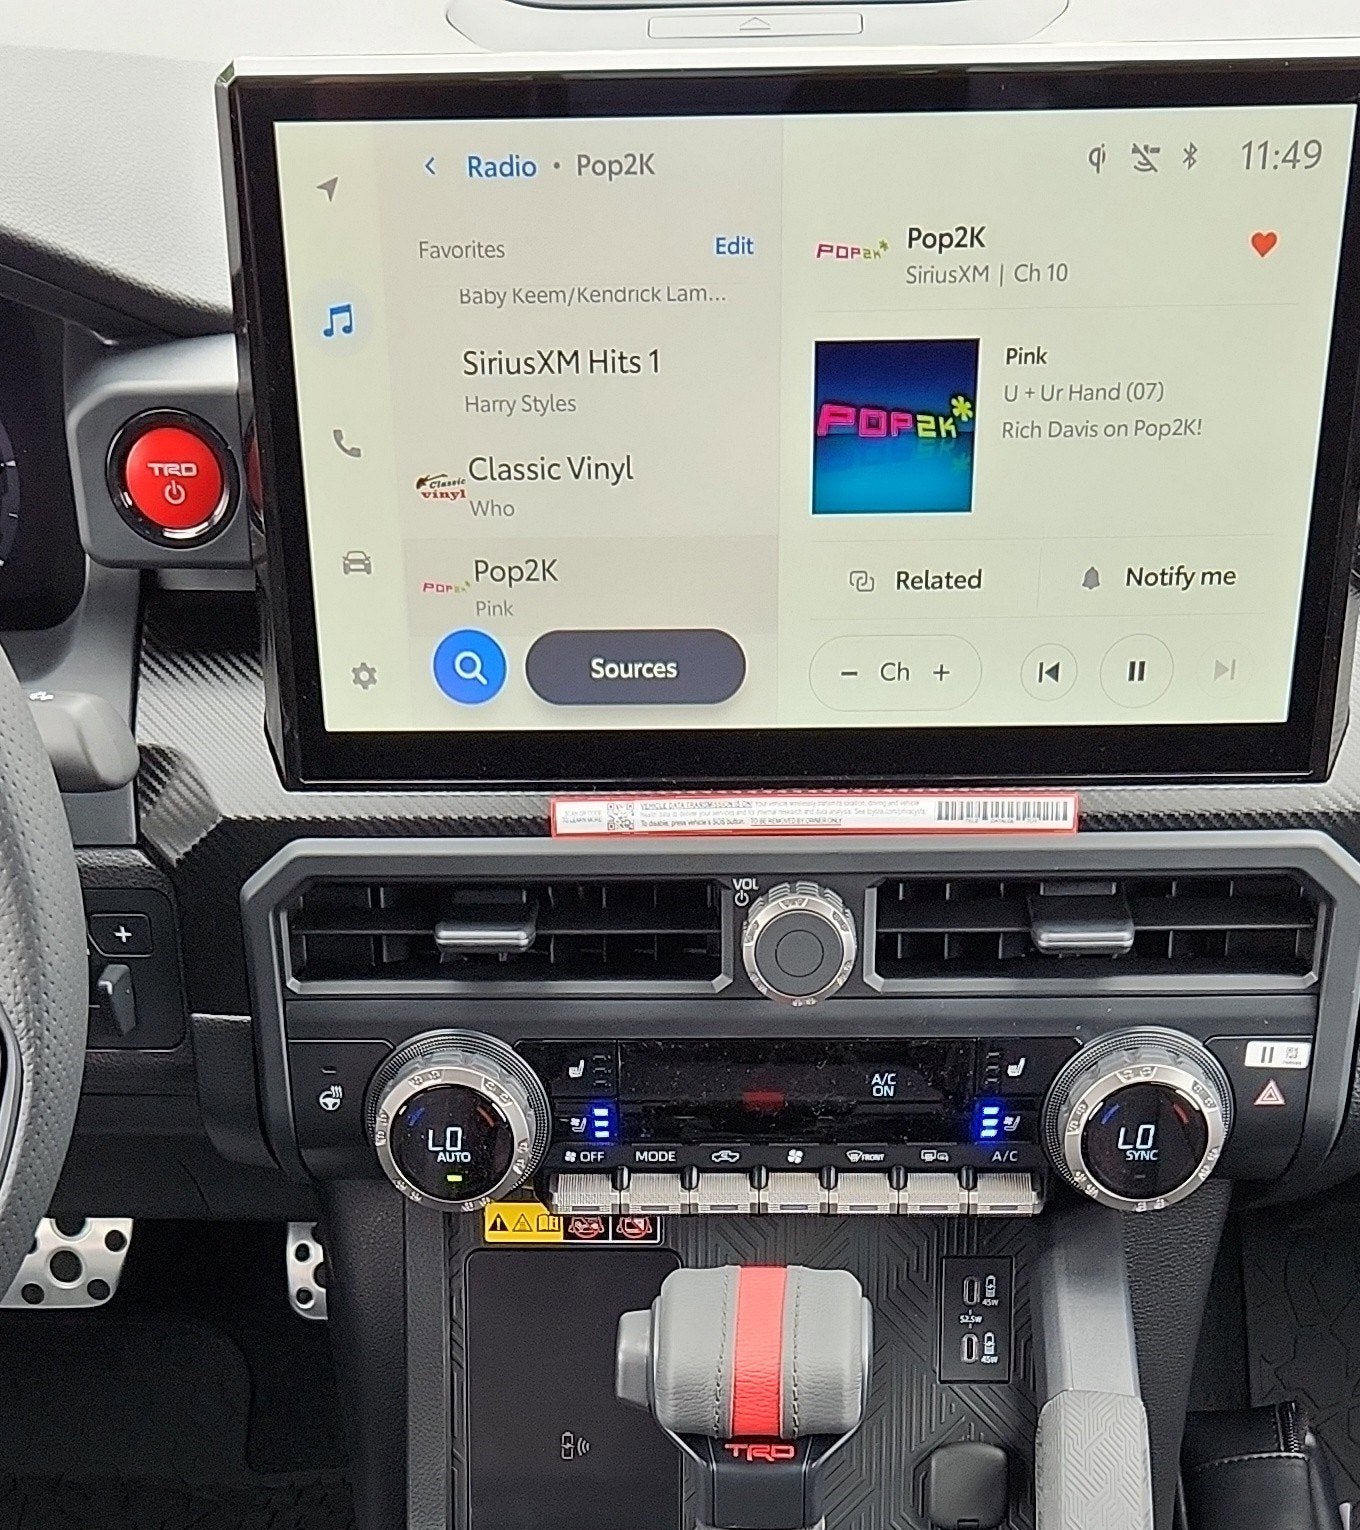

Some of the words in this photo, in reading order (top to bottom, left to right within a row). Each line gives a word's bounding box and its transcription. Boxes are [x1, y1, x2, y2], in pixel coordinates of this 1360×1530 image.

[1242, 139, 1323, 170] 11:49
[467, 155, 537, 178] Radio
[577, 154, 655, 182] Pop2K
[419, 239, 505, 259] Favorites
[716, 237, 754, 256] Edit
[908, 227, 986, 254] Pop2K
[907, 264, 989, 284] SiriusXM
[1014, 263, 1041, 283] Ch
[1047, 263, 1068, 282] 10
[459, 288, 506, 308] Baby
[513, 286, 661, 306] Keem/Kendrick
[463, 349, 579, 376] SiriusXM
[589, 349, 641, 374] Hits
[649, 349, 660, 373] 1
[1006, 347, 1047, 365] Pink
[1004, 385, 1017, 402] U
[1041, 384, 1063, 401] Ur
[1069, 382, 1121, 401] Hand
[1127, 380, 1164, 402] (07)
[465, 396, 516, 417] Harry
[521, 395, 577, 415] Styles
[1002, 420, 1041, 438] Rich
[1048, 419, 1099, 438] Davis
[1104, 423, 1128, 437] on
[1134, 418, 1202, 441] Pop2K!
[146, 462, 197, 477] TRD
[469, 457, 561, 482] Classic
[567, 455, 634, 486] Vinyl
[421, 490, 466, 500] vinyl
[470, 500, 515, 517] Who
[475, 559, 558, 587] Pop2K
[896, 570, 982, 591] Related
[1126, 567, 1195, 592] Notify
[1201, 569, 1236, 587] me
[476, 601, 513, 617] Pink
[591, 659, 678, 678] Sources
[880, 661, 910, 682] Ch
[732, 878, 759, 890] VOL
[871, 1073, 896, 1086] A/C
[872, 1086, 894, 1097] ON
[428, 1127, 462, 1151] LO
[1118, 1124, 1155, 1150] LO
[437, 1152, 471, 1163] AUTO
[579, 1152, 605, 1163] OFF
[635, 1151, 676, 1163] MODE
[861, 1152, 885, 1162] FRONT
[991, 1150, 1018, 1162] A/C
[1126, 1150, 1158, 1161] SYNC
[981, 1299, 999, 1307] 45W
[980, 1356, 999, 1364] 45W
[725, 1443, 796, 1462] TRD
